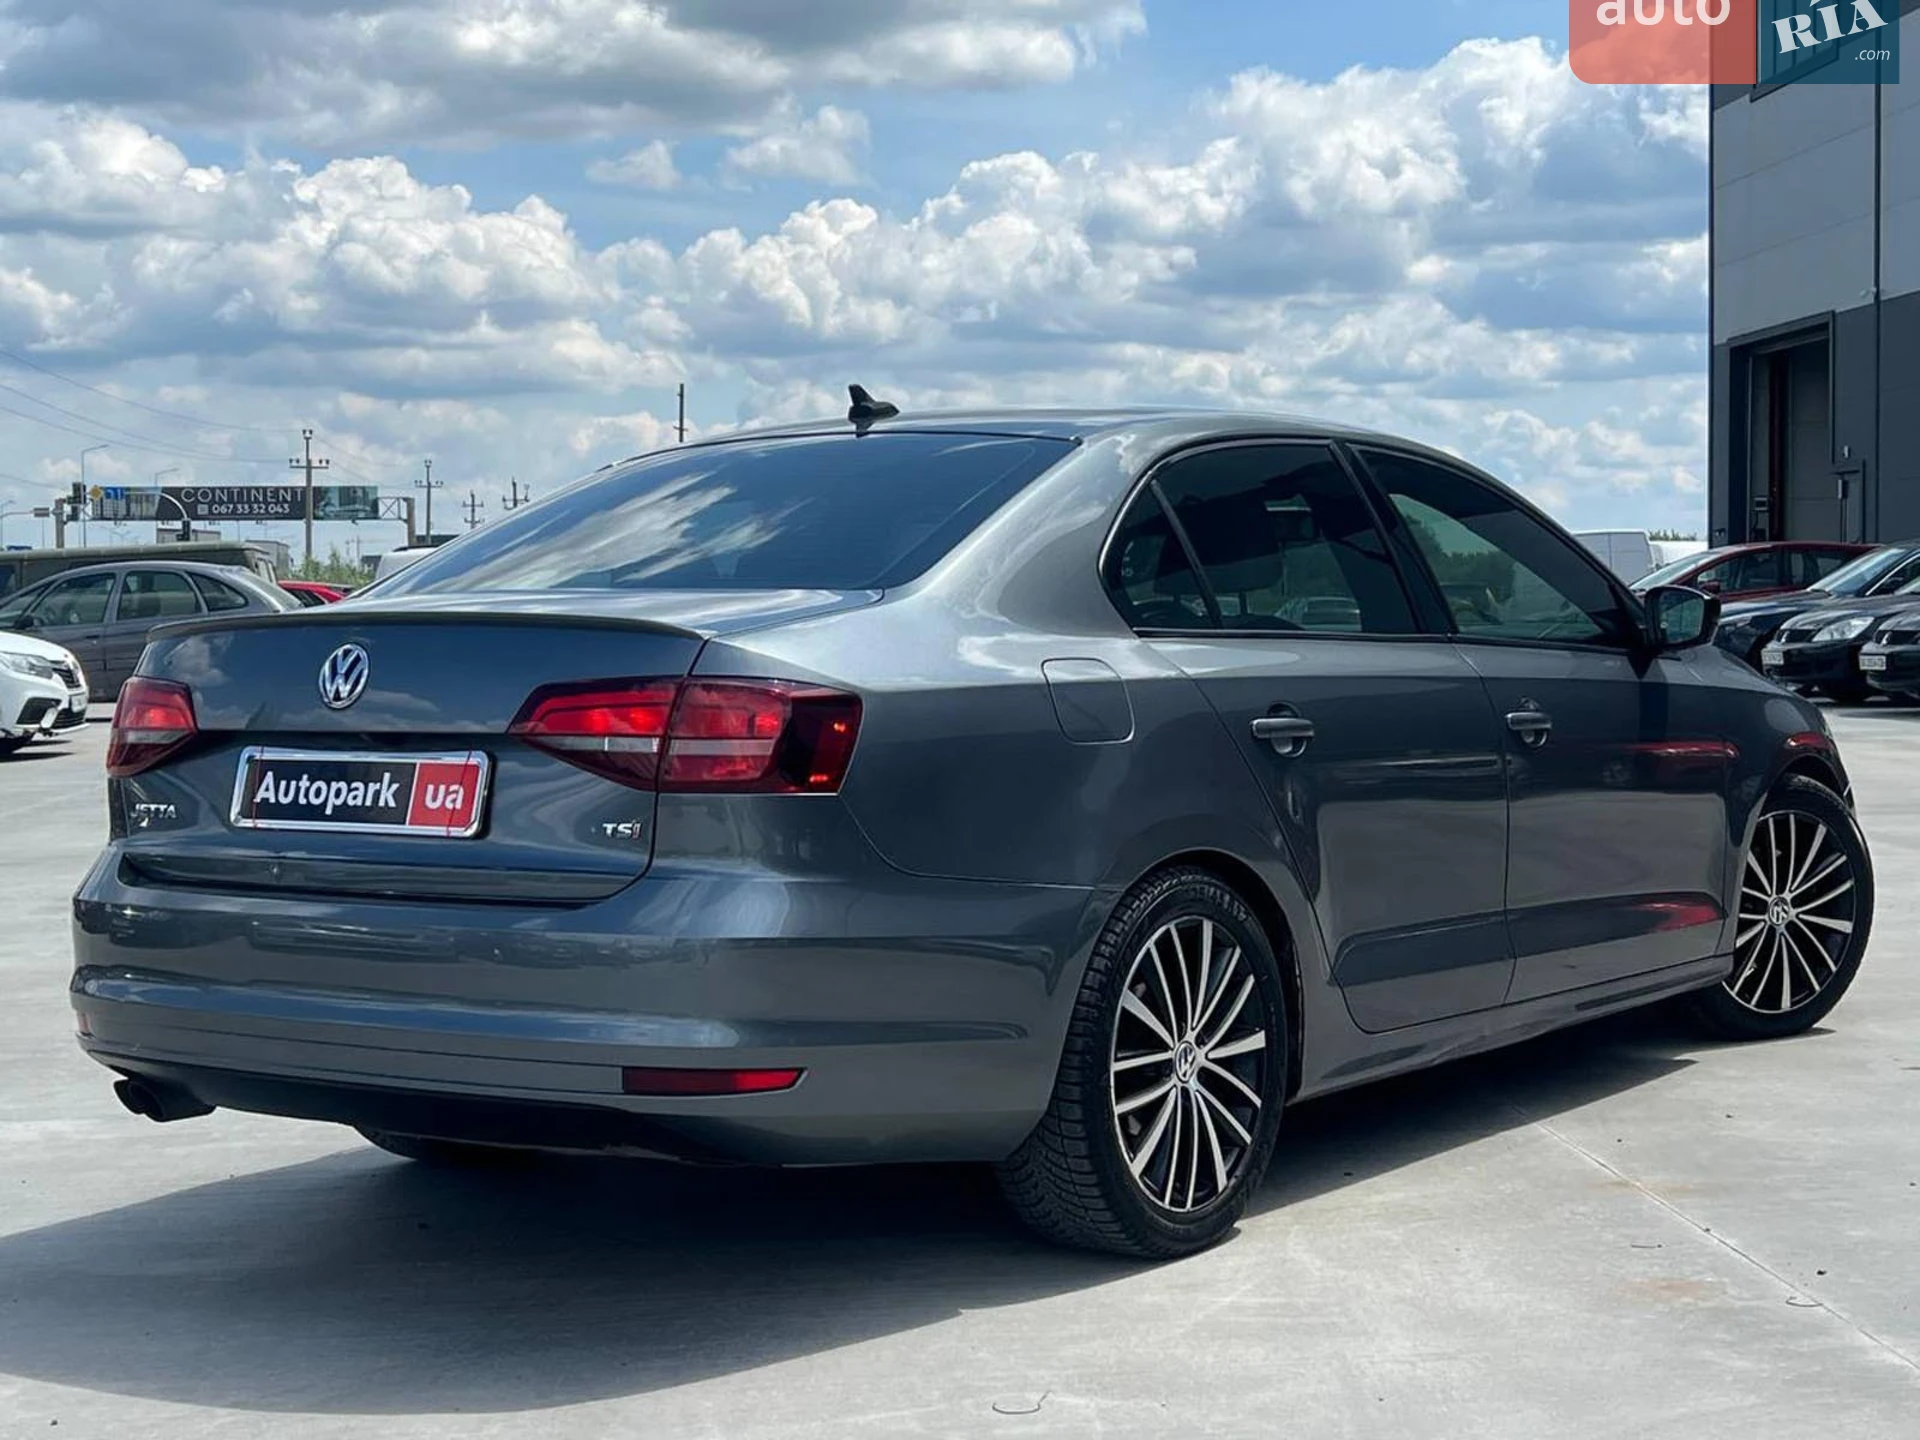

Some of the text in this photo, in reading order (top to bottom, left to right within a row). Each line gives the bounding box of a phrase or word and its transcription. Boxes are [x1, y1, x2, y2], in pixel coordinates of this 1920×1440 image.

[181, 488, 304, 502] CONTINENT
[212, 503, 234, 514] 067
[268, 503, 290, 514] 043
[253, 771, 465, 815] Autopark ua
[130, 803, 177, 818] JETTA
